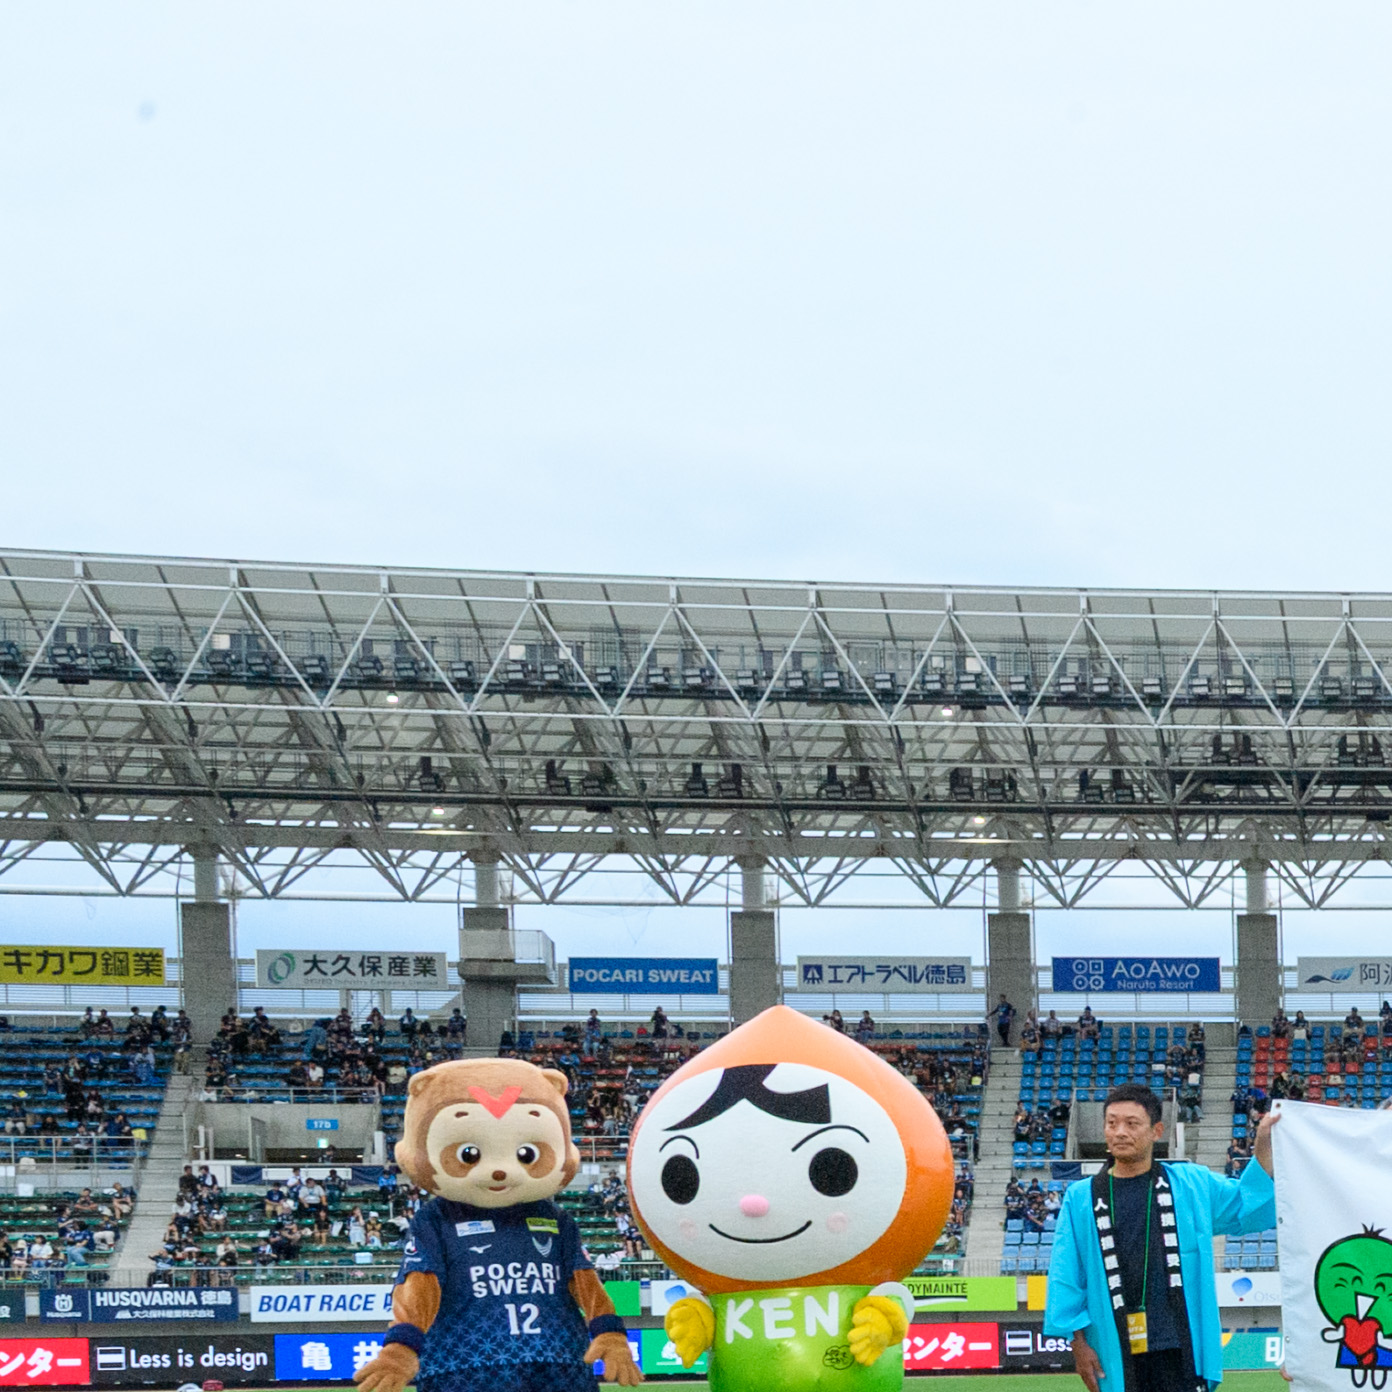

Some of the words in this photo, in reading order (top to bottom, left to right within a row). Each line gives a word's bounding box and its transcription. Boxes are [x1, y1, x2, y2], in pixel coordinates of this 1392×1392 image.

[303, 953, 437, 978] 大久保産業
[573, 968, 645, 983] POCARI
[648, 968, 714, 983] SWEAT
[827, 964, 967, 985] エアトラベル徳島
[1116, 979, 1156, 990] Naruto
[1159, 979, 1194, 990] Resort
[469, 1262, 561, 1282] POCARI
[473, 1278, 556, 1298] SWEAT
[96, 1290, 198, 1307] HUSQVARNA
[200, 1290, 233, 1306] 徳島
[258, 1294, 315, 1313] BOAT
[318, 1293, 376, 1312] RACE
[504, 1303, 541, 1336] 12
[725, 1291, 839, 1345] KEN
[129, 1349, 171, 1369] Less
[178, 1348, 194, 1368] is
[200, 1345, 268, 1371] design
